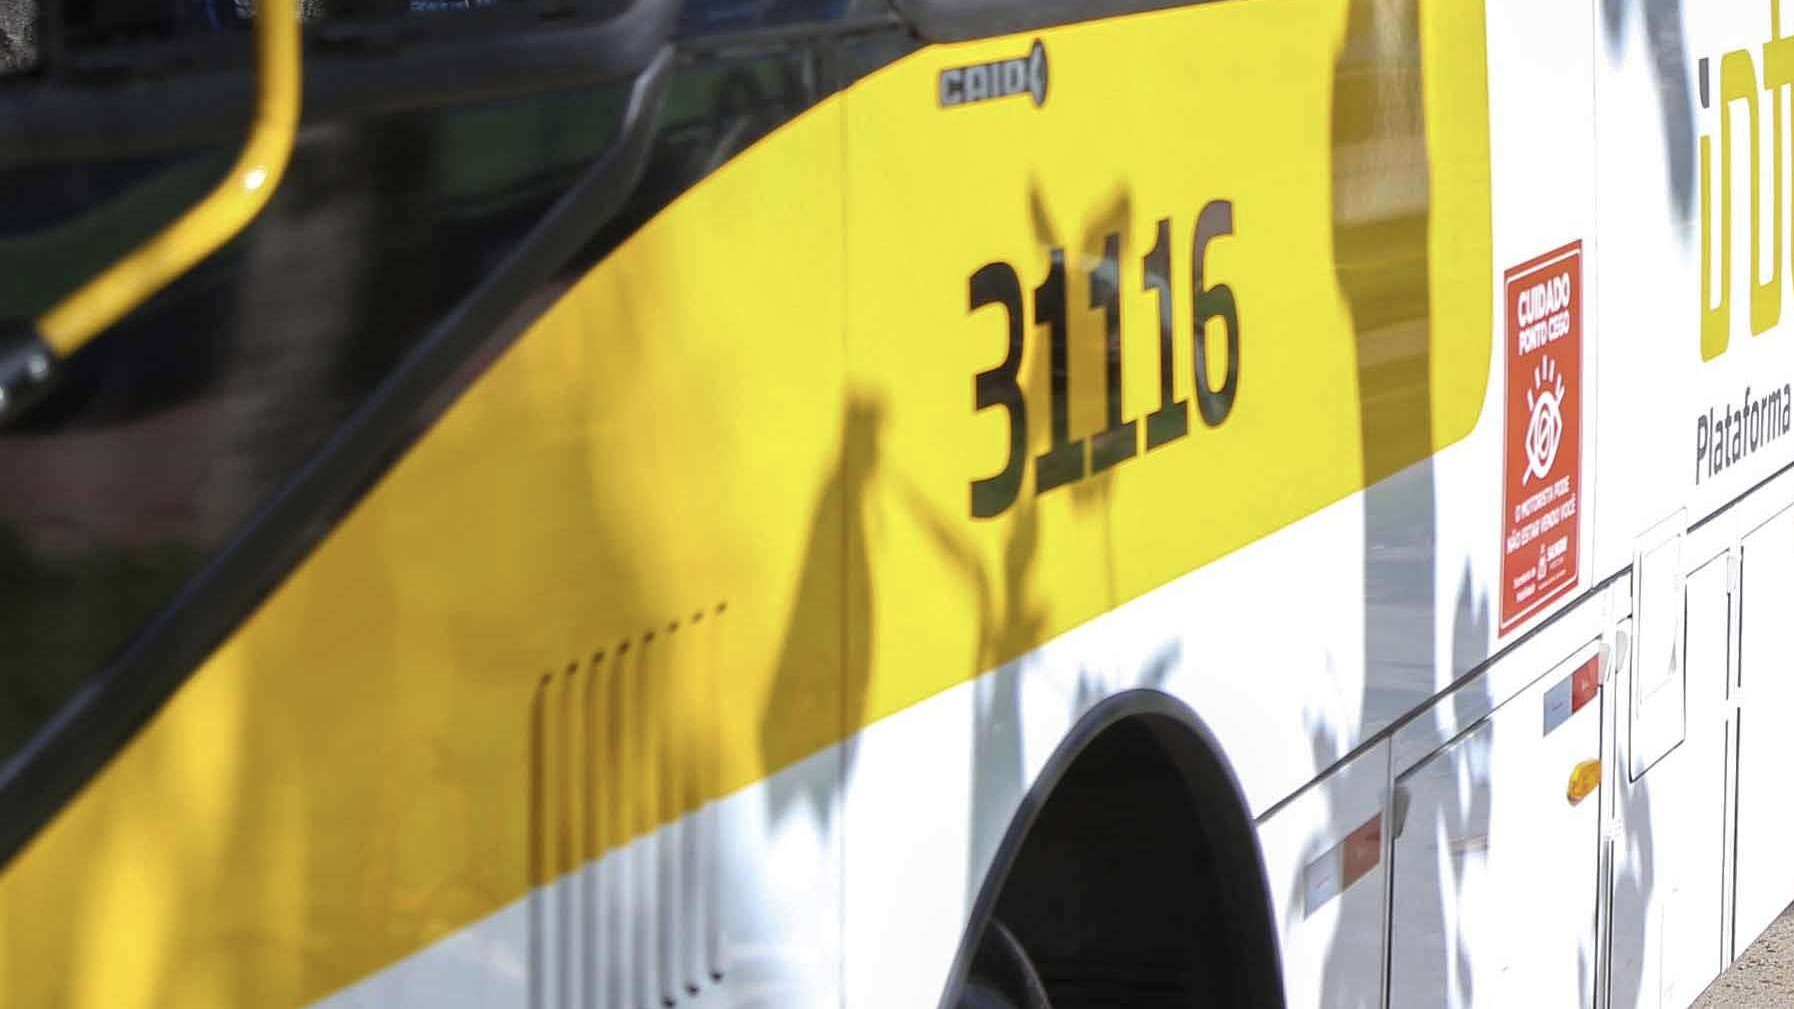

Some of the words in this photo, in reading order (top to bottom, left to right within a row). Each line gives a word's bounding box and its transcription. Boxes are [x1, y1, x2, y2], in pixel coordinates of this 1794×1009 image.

[1518, 272, 1571, 328] CUIDADO
[968, 198, 1240, 519] 31116
[1696, 383, 1791, 485] Plataforma
